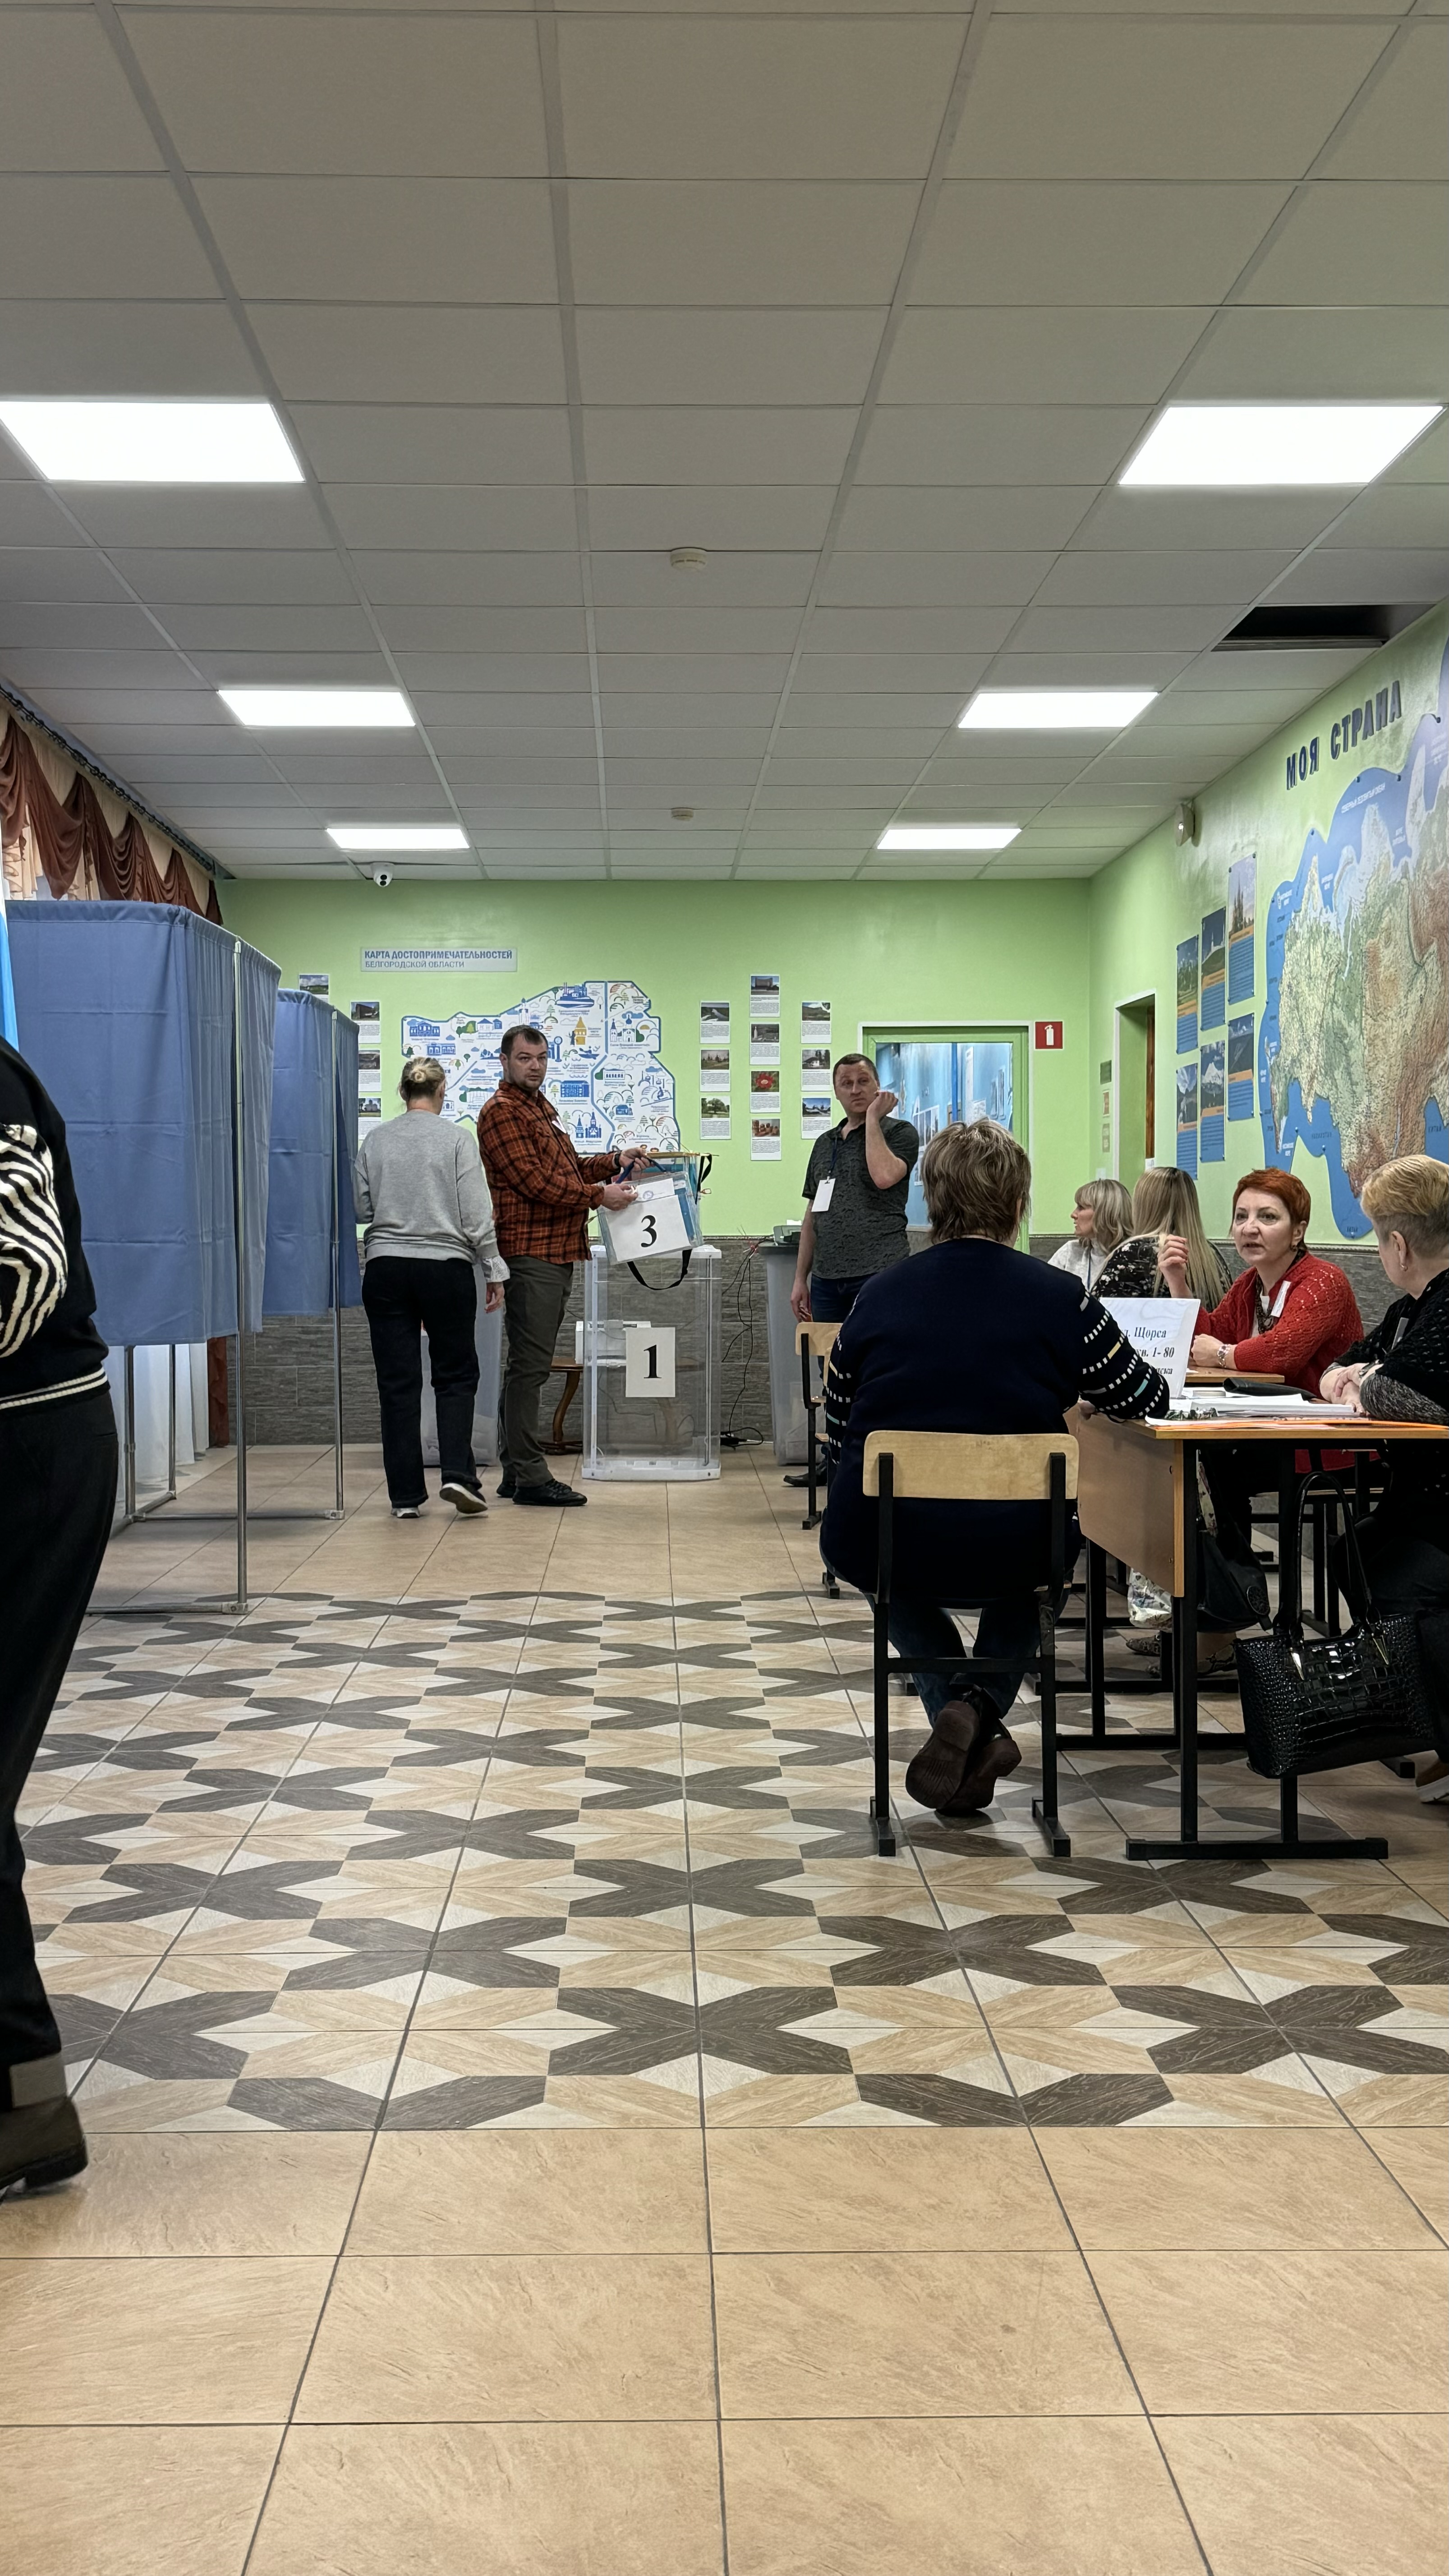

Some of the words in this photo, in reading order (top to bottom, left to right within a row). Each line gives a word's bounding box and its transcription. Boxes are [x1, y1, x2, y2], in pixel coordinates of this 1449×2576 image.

[1287, 736, 1319, 791] МОЯ
[1331, 680, 1402, 760] СТРАНА
[365, 951, 390, 959] КАРТА
[392, 950, 512, 960] ДОСТОПРИМЕЧАТЕЛЬНОСТЕЙ
[365, 960, 426, 968] БЕЛГОРОДСКОЙ
[641, 1215, 657, 1247] 3
[1134, 1327, 1166, 1341] Щорса
[643, 1344, 662, 1379] 1
